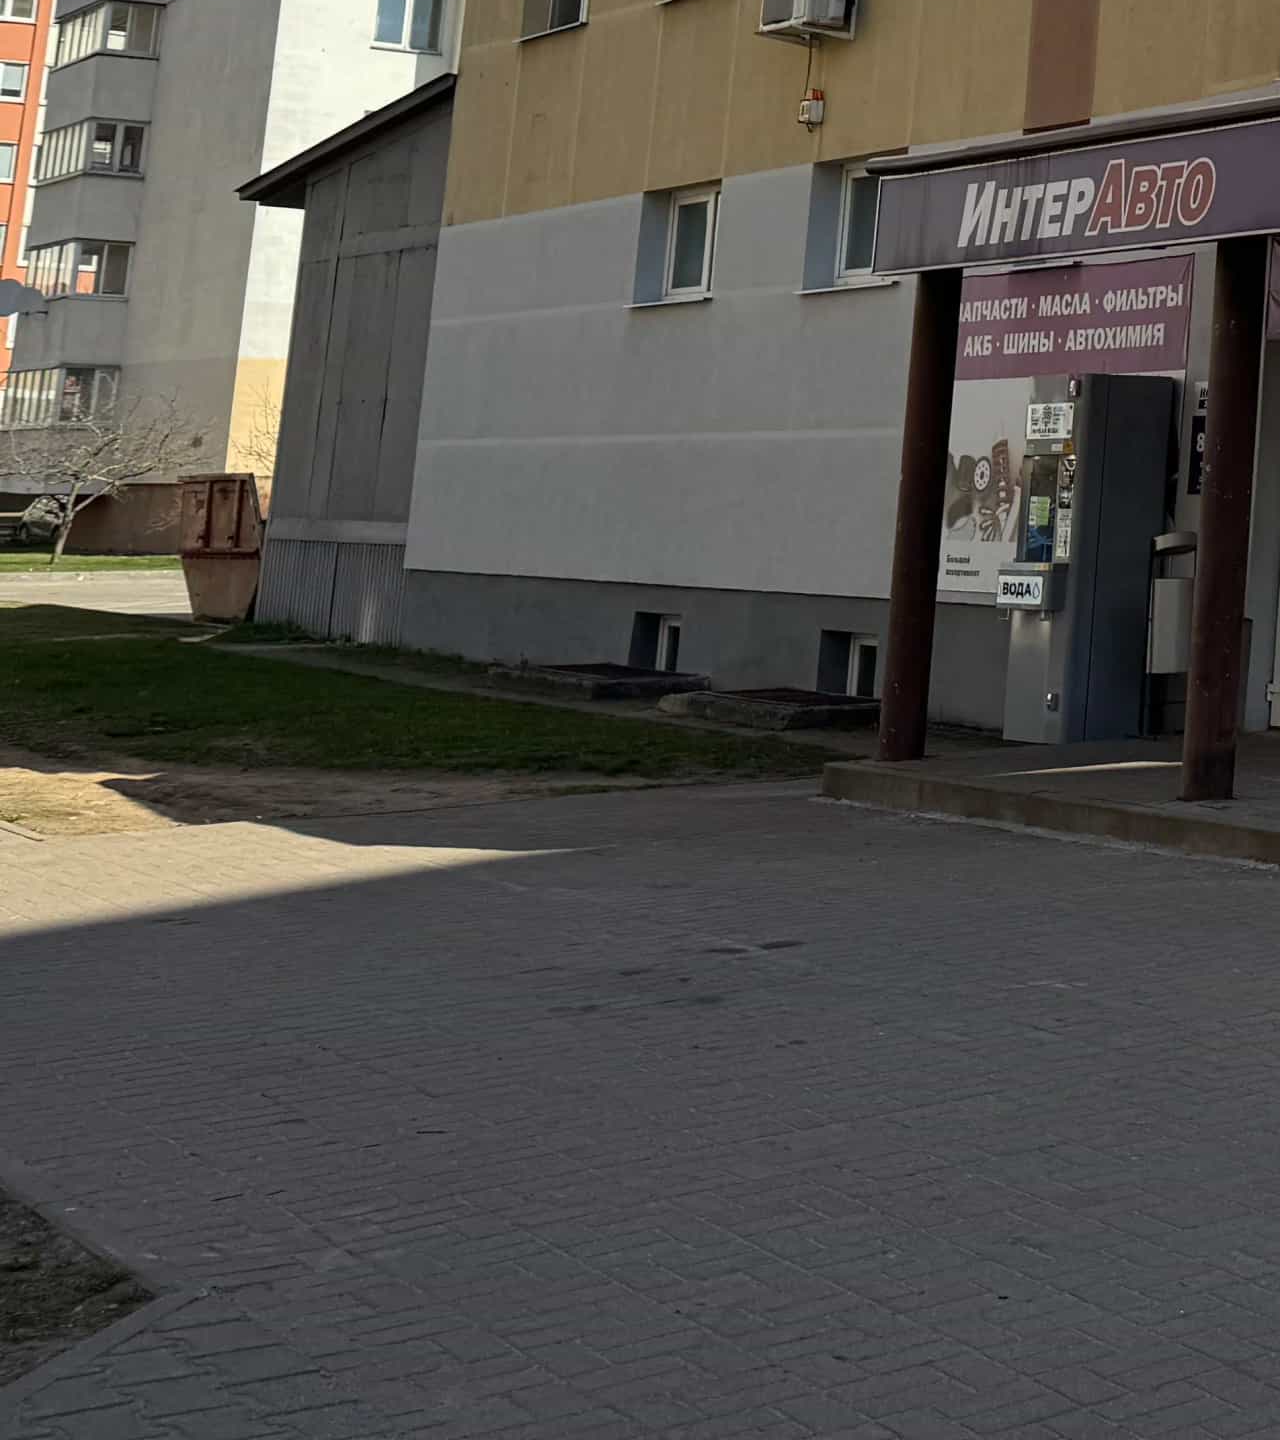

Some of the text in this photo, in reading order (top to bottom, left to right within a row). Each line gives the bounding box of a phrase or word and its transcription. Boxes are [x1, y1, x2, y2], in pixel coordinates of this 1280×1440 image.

[960, 284, 1184, 322] АПЧАСТИ МАСЛА ФИЛЬТРЫ
[963, 323, 1166, 357] АКБ ШИНЫ АВТОХИМИЯ
[1003, 582, 1032, 598] ВОДА
